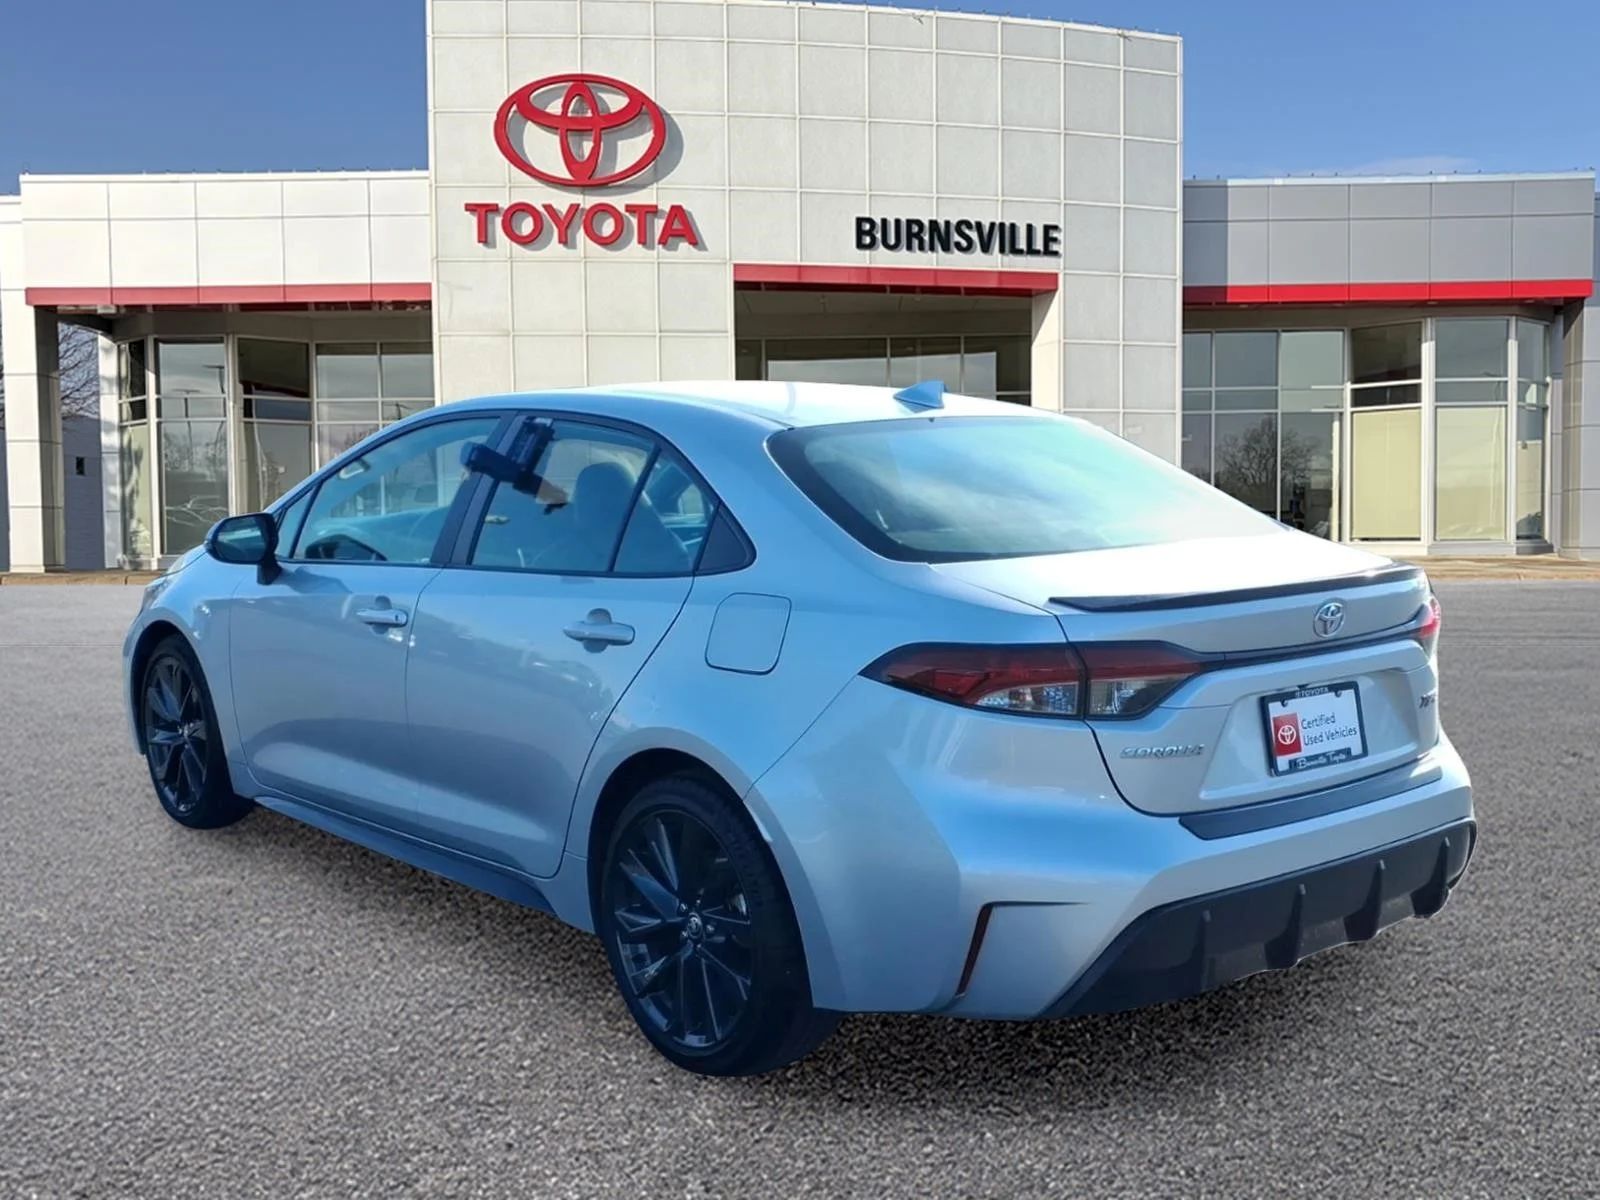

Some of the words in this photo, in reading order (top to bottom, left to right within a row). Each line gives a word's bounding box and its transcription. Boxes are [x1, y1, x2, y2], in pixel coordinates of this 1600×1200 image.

[464, 202, 698, 246] TOYOTA
[855, 216, 1061, 256] BURNSVILLE
[1302, 686, 1329, 697] TOYOTA
[1301, 711, 1336, 729] Certified
[1303, 732, 1324, 747] Used
[1325, 725, 1358, 741] Vehicles
